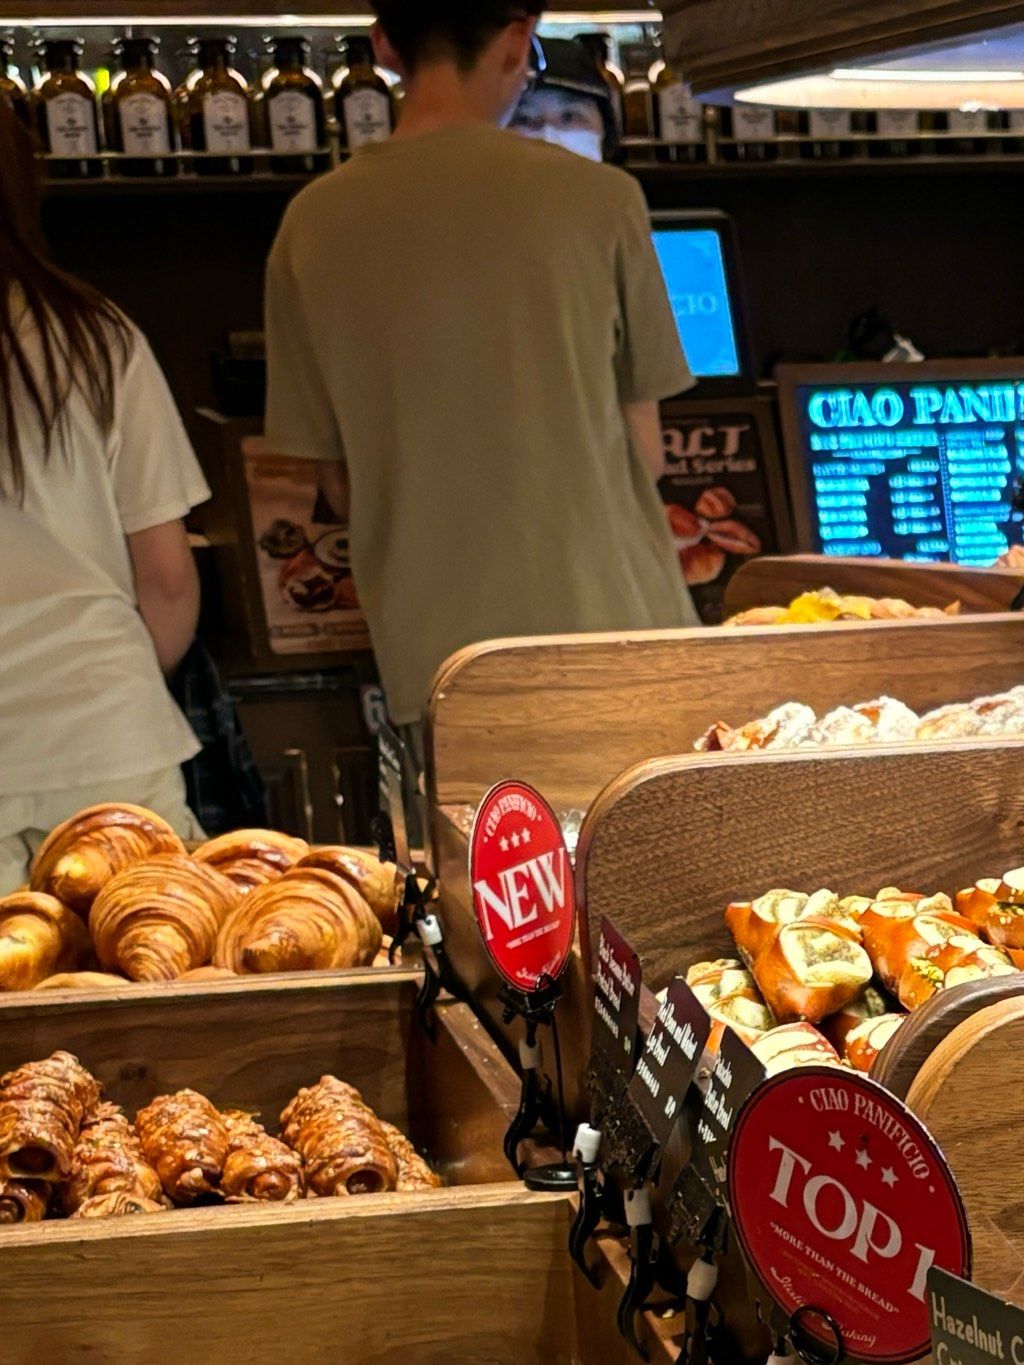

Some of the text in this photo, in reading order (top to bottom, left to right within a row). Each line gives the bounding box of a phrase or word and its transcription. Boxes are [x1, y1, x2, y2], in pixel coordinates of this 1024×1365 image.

[808, 387, 904, 428] CIAO
[474, 847, 565, 941] NEW
[810, 1088, 930, 1179] CIAO PANIFICIO
[769, 1135, 902, 1264] TOP
[907, 1243, 936, 1303] 1
[805, 1245, 834, 1271] THAN
[835, 1267, 857, 1287] THE
[931, 1292, 1004, 1360] Hazelnut
